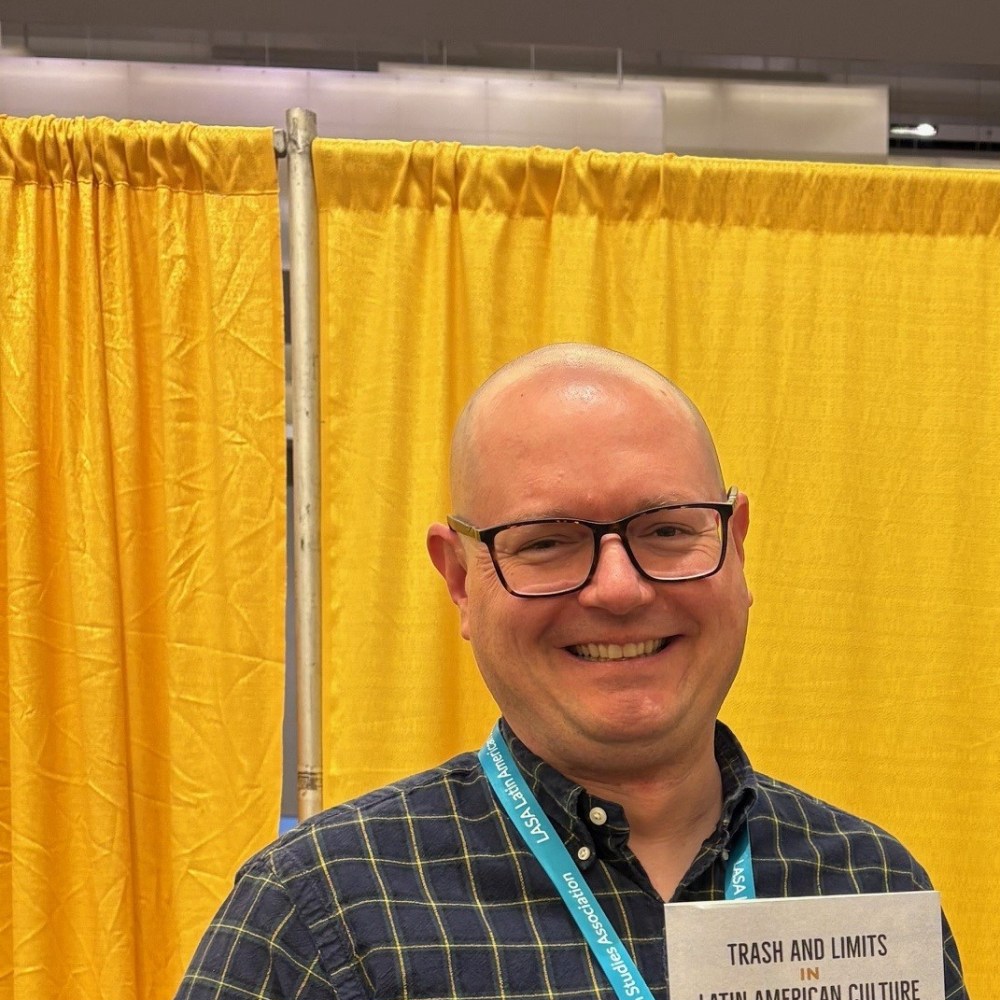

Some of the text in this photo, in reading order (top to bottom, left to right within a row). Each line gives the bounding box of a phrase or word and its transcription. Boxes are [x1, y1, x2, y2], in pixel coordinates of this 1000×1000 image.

[504, 775, 551, 845] LASA Latin
[562, 871, 614, 946] Association
[606, 945, 641, 998] Studies
[727, 933, 889, 966] TRASH AND LIMITS
[800, 967, 821, 982] IN
